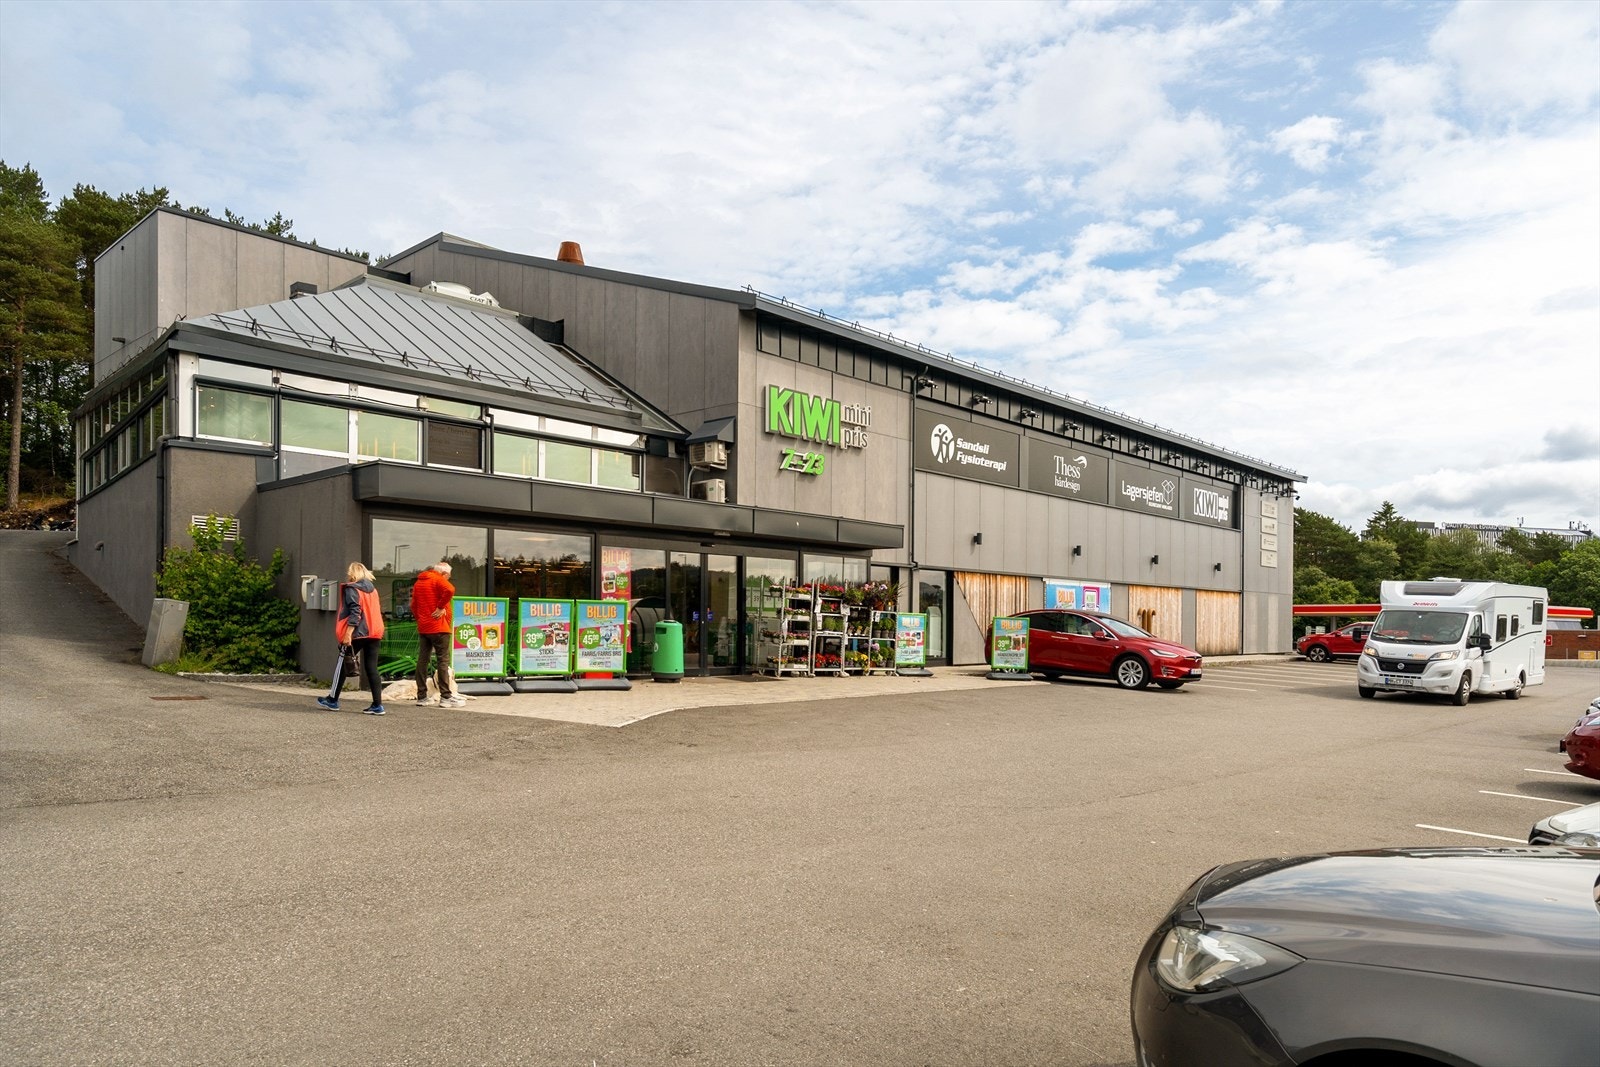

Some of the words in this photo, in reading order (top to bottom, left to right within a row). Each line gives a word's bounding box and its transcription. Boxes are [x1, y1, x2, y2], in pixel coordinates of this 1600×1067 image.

[767, 384, 841, 446] KIWI
[843, 403, 871, 426] mini
[842, 426, 868, 450] pris
[955, 437, 990, 455] Sandsli
[779, 447, 826, 476] 7-23
[955, 451, 1008, 472] Fysioterapi
[1053, 455, 1081, 479] Thess
[1054, 475, 1081, 494] hårdesign
[1121, 480, 1164, 504] Lagersjefen
[1193, 488, 1219, 520] KIWI
[602, 550, 630, 564] BILLIG
[463, 601, 497, 616] BILLIG
[530, 603, 562, 617] BILLIG
[587, 605, 617, 619] BILLIG
[1001, 620, 1023, 630] BILLIG
